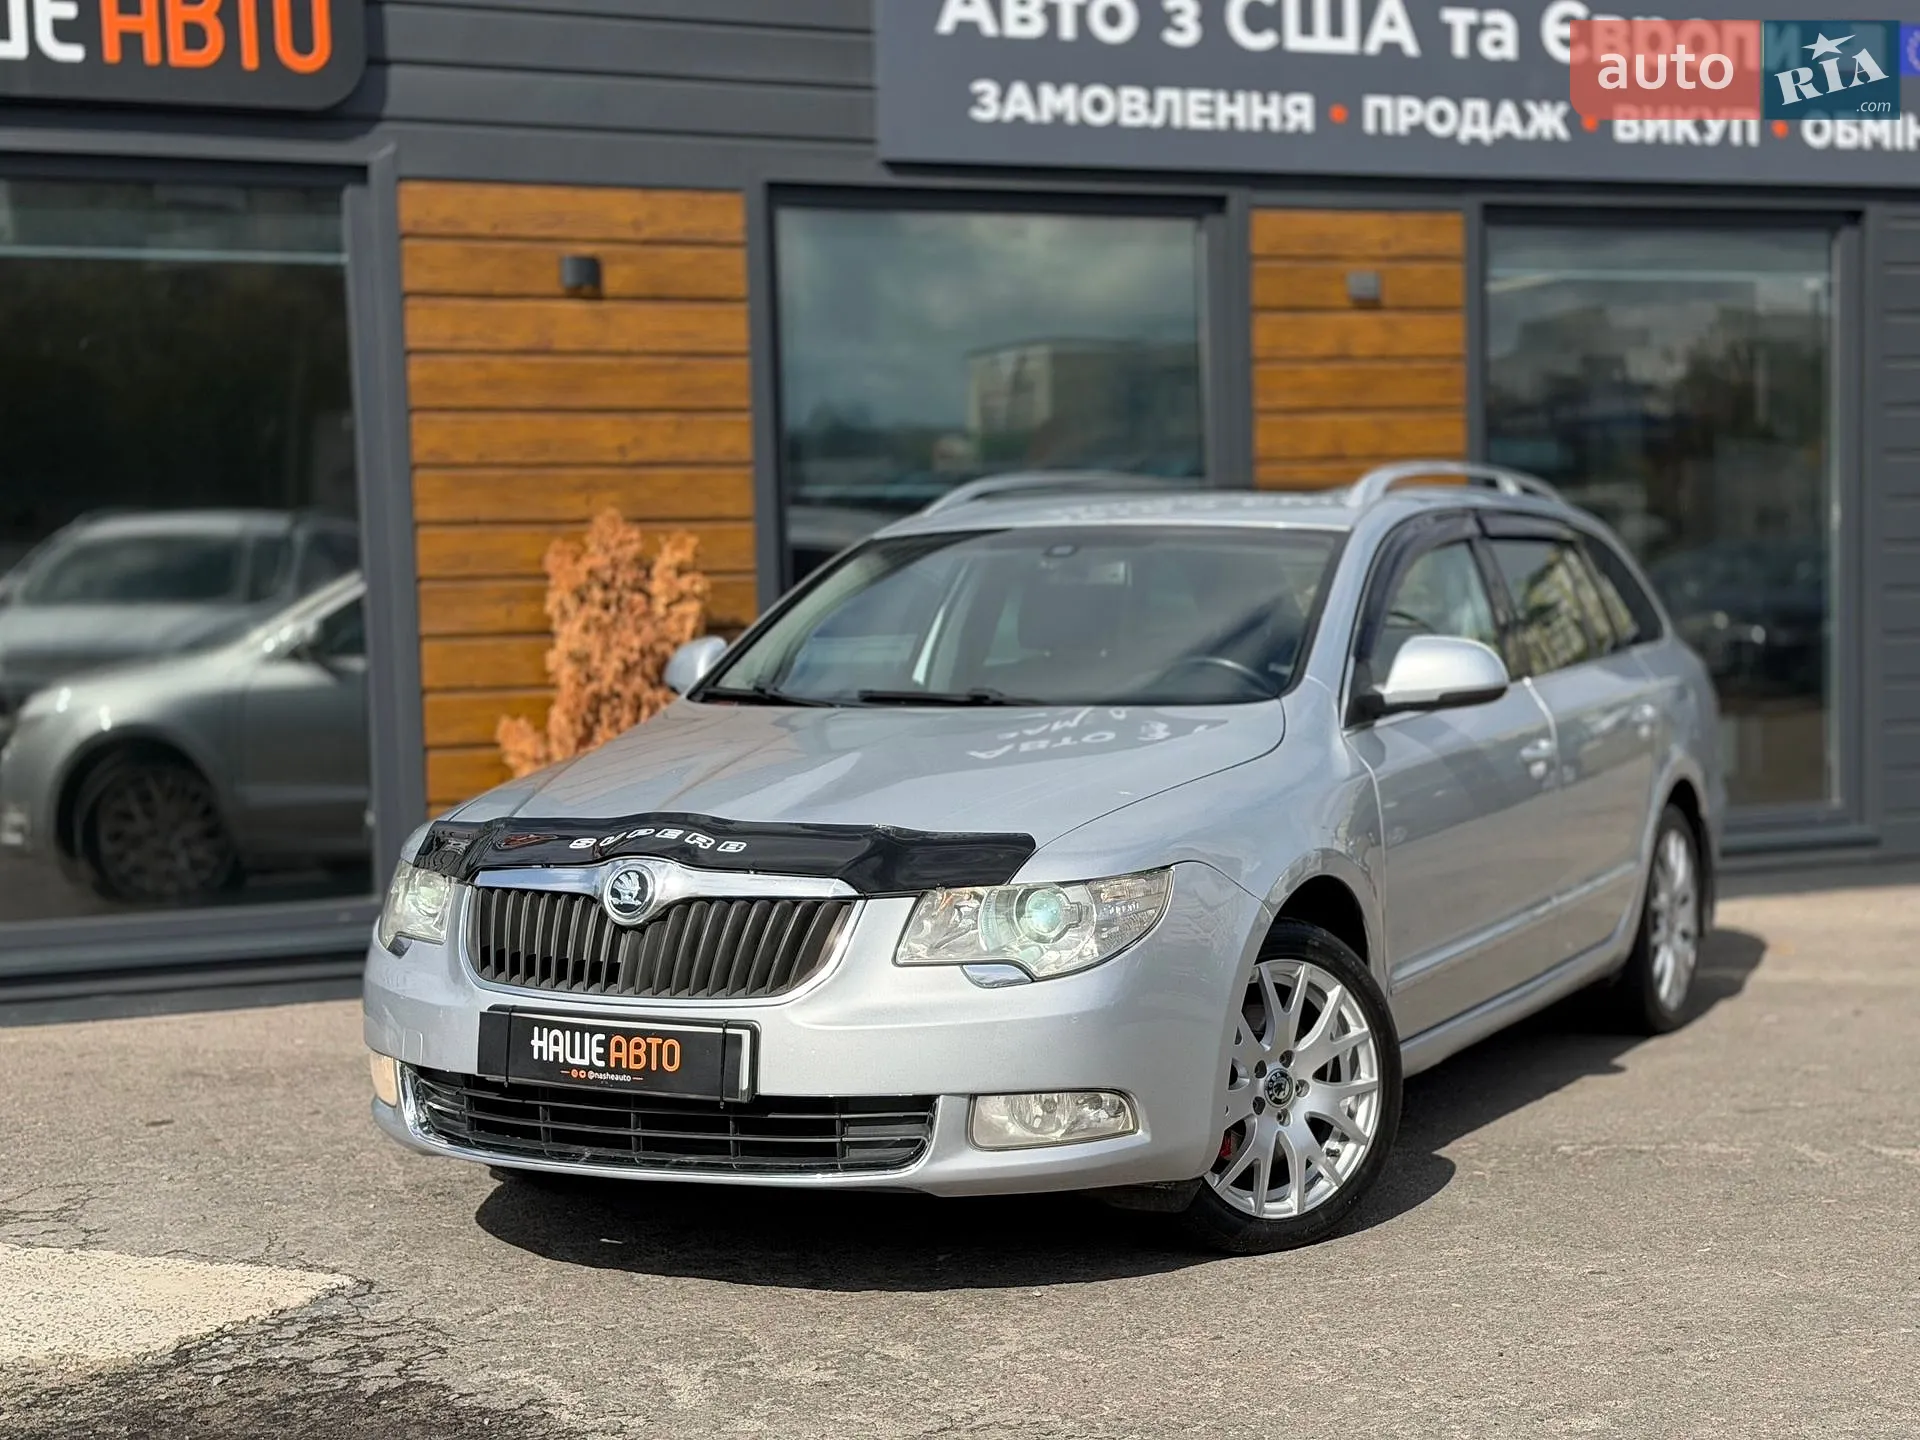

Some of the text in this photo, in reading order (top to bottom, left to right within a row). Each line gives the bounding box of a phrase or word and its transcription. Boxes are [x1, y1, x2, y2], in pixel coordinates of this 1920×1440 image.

[101, 0, 332, 74] АВТО
[936, 0, 1139, 44] Авто
[1225, 0, 1421, 57] США
[1440, 7, 1519, 62] та
[969, 79, 1315, 134] ЗАМОВЛЕННЯ
[1362, 94, 1570, 145] ПРОДАЖ
[1612, 105, 1760, 147] ВИКУП
[569, 828, 747, 852] SUPERB
[530, 1025, 681, 1072] НАШЕ АВТО
[587, 1070, 632, 1082] @nasheauto
